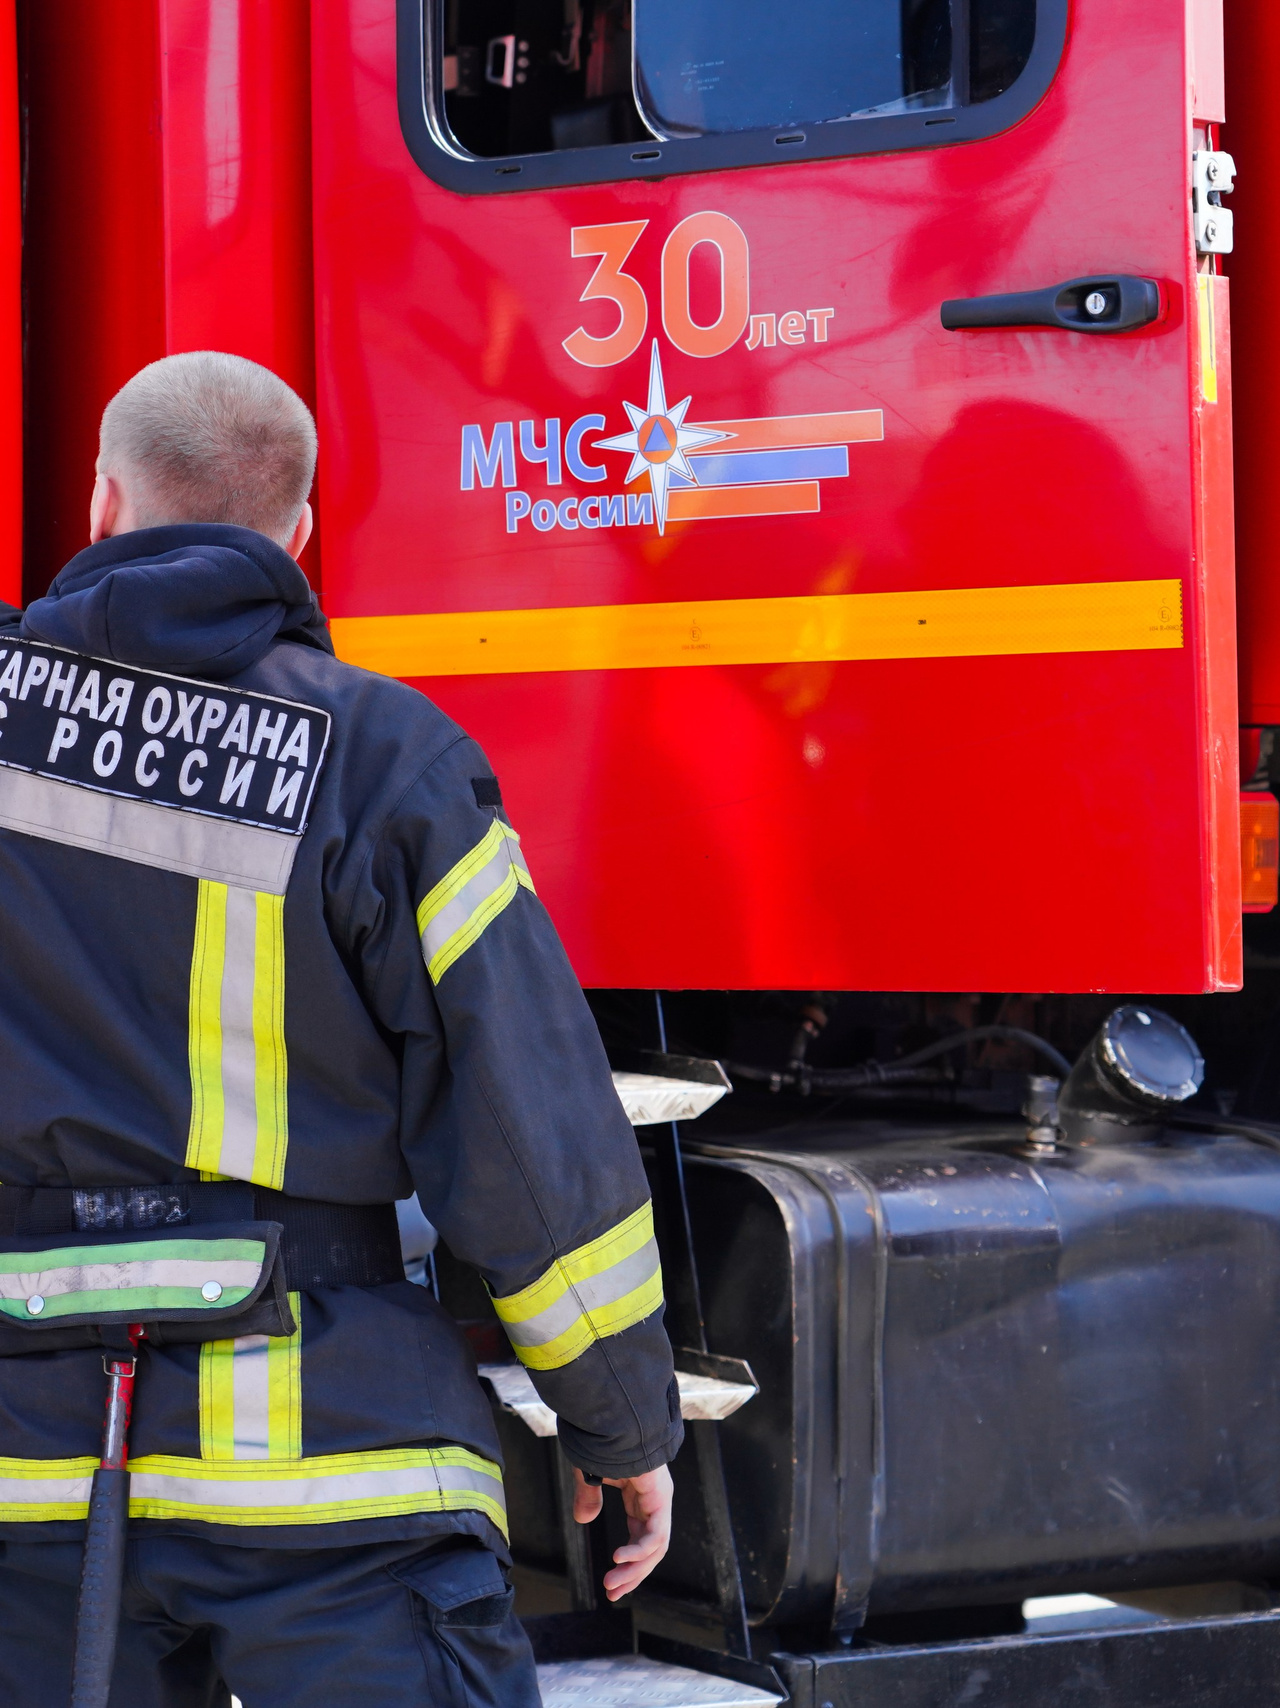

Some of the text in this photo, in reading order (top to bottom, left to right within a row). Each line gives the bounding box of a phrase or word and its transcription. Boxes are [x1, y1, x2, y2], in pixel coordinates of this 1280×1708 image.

[562, 210, 835, 368] 30 лет
[460, 414, 607, 491] МЧС
[506, 490, 653, 533] России
[141, 686, 310, 767] ОХРАНА
[47, 718, 305, 818] РОССИИ
